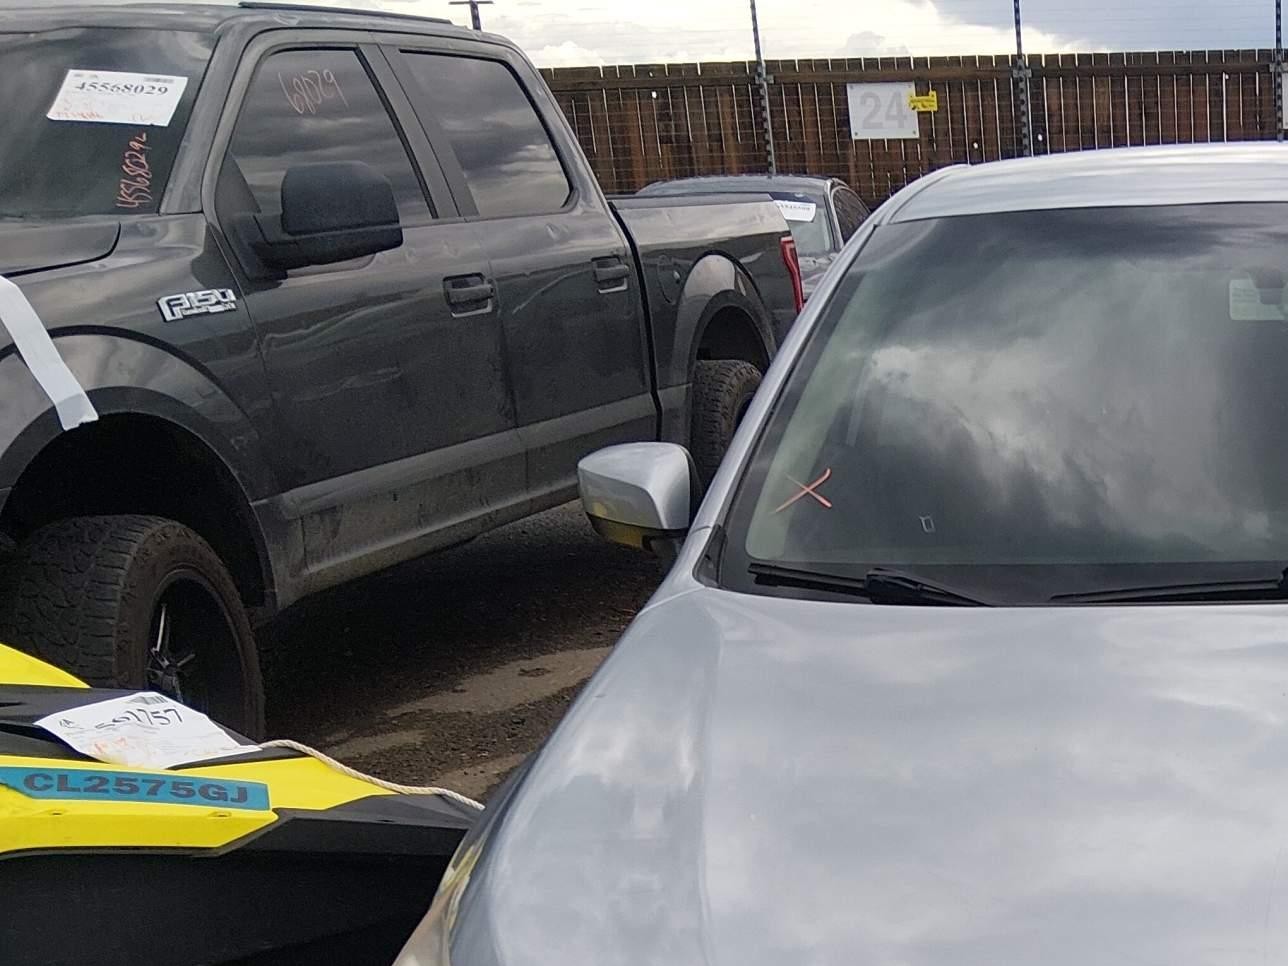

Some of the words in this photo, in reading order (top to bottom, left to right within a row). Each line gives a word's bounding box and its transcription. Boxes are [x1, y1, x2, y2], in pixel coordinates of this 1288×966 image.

[75, 82, 168, 95] 45568029
[860, 91, 907, 129] 24
[23, 773, 248, 803] CL2575GJ
